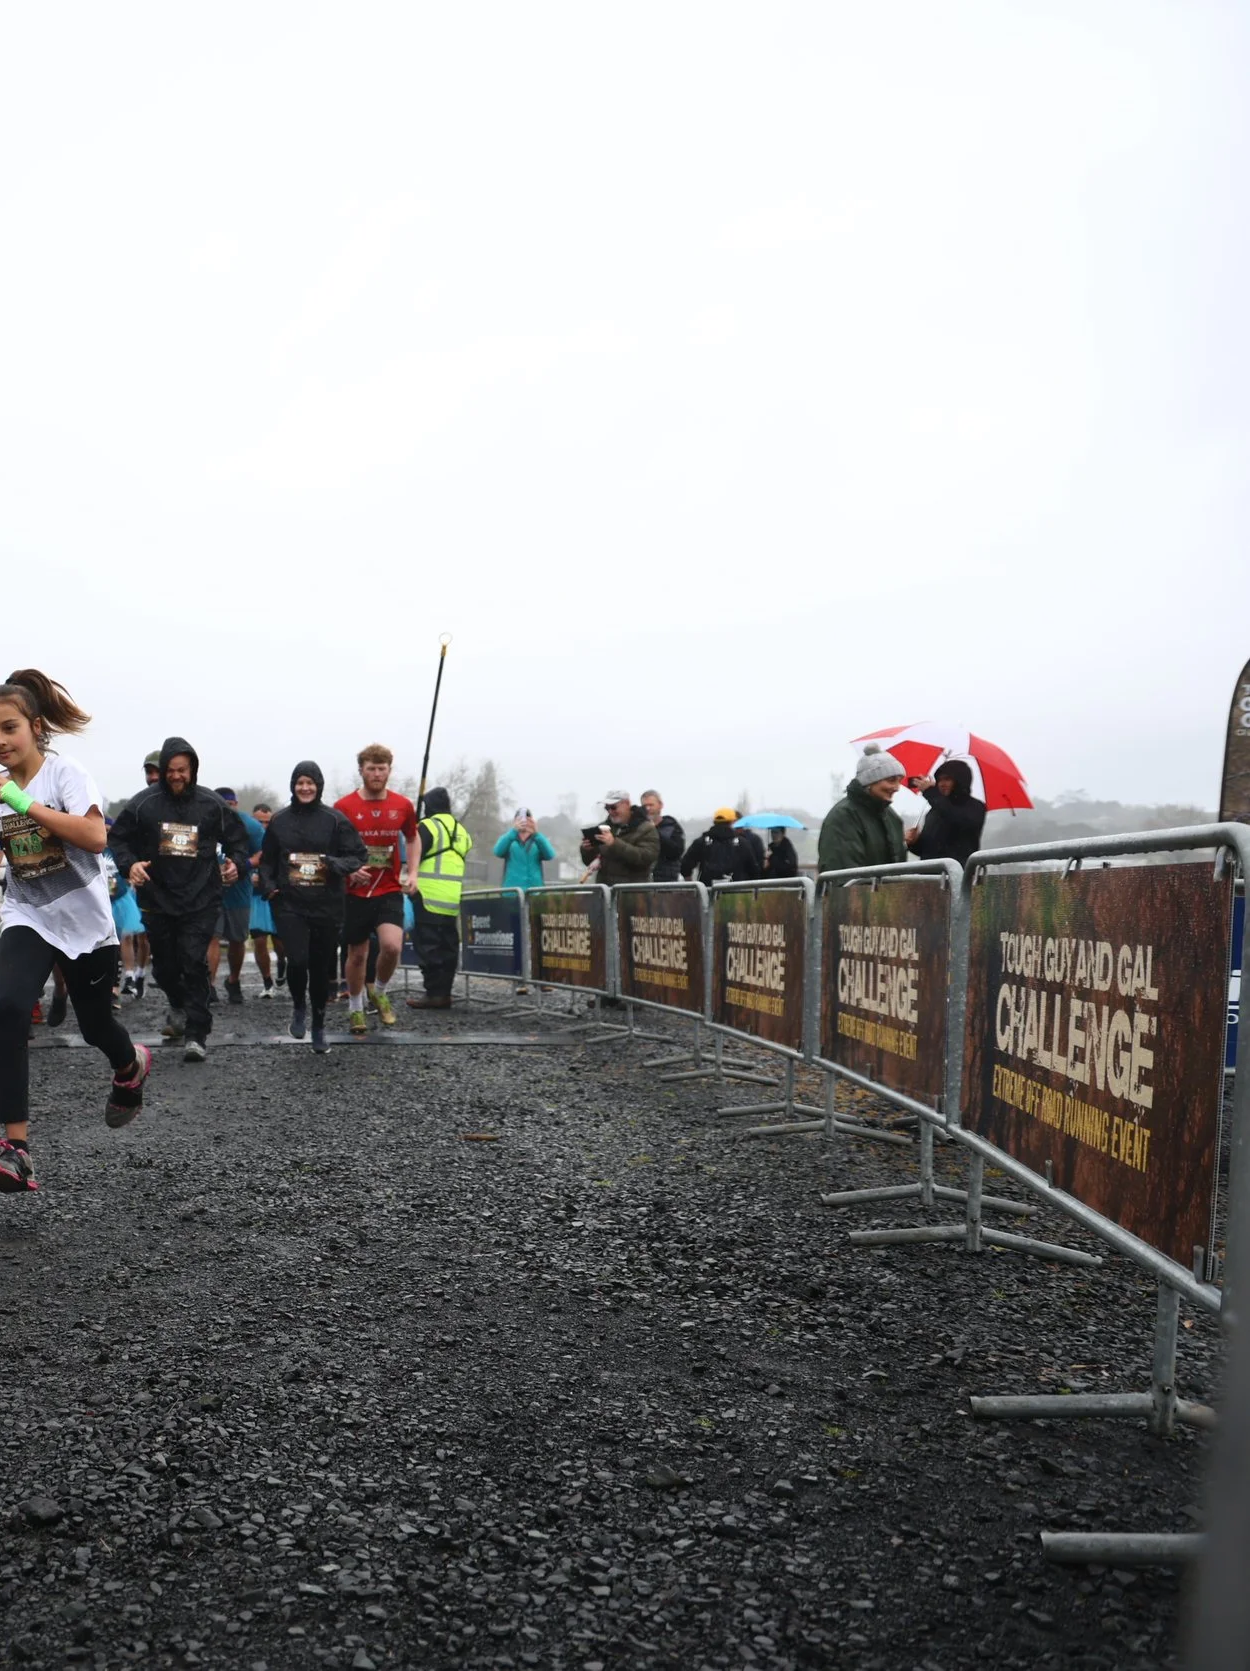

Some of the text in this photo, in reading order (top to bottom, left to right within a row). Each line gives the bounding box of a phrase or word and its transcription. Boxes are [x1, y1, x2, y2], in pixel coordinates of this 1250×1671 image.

[541, 930, 591, 955] CHALLENGE
[632, 935, 688, 970] CHALLENGE
[727, 922, 786, 947] TOUGH GUY AND GAL
[838, 924, 919, 960] TOUGH GUY AND GAL
[726, 947, 786, 991] CHALLENGE
[1000, 931, 1159, 1000] TOUGH GUY AND GAL
[838, 958, 919, 1023] CHALLENGE
[996, 983, 1157, 1109] CHALLENGE
[992, 1064, 1150, 1174] EXTREME OFF ROAD RUNNING EVENT
